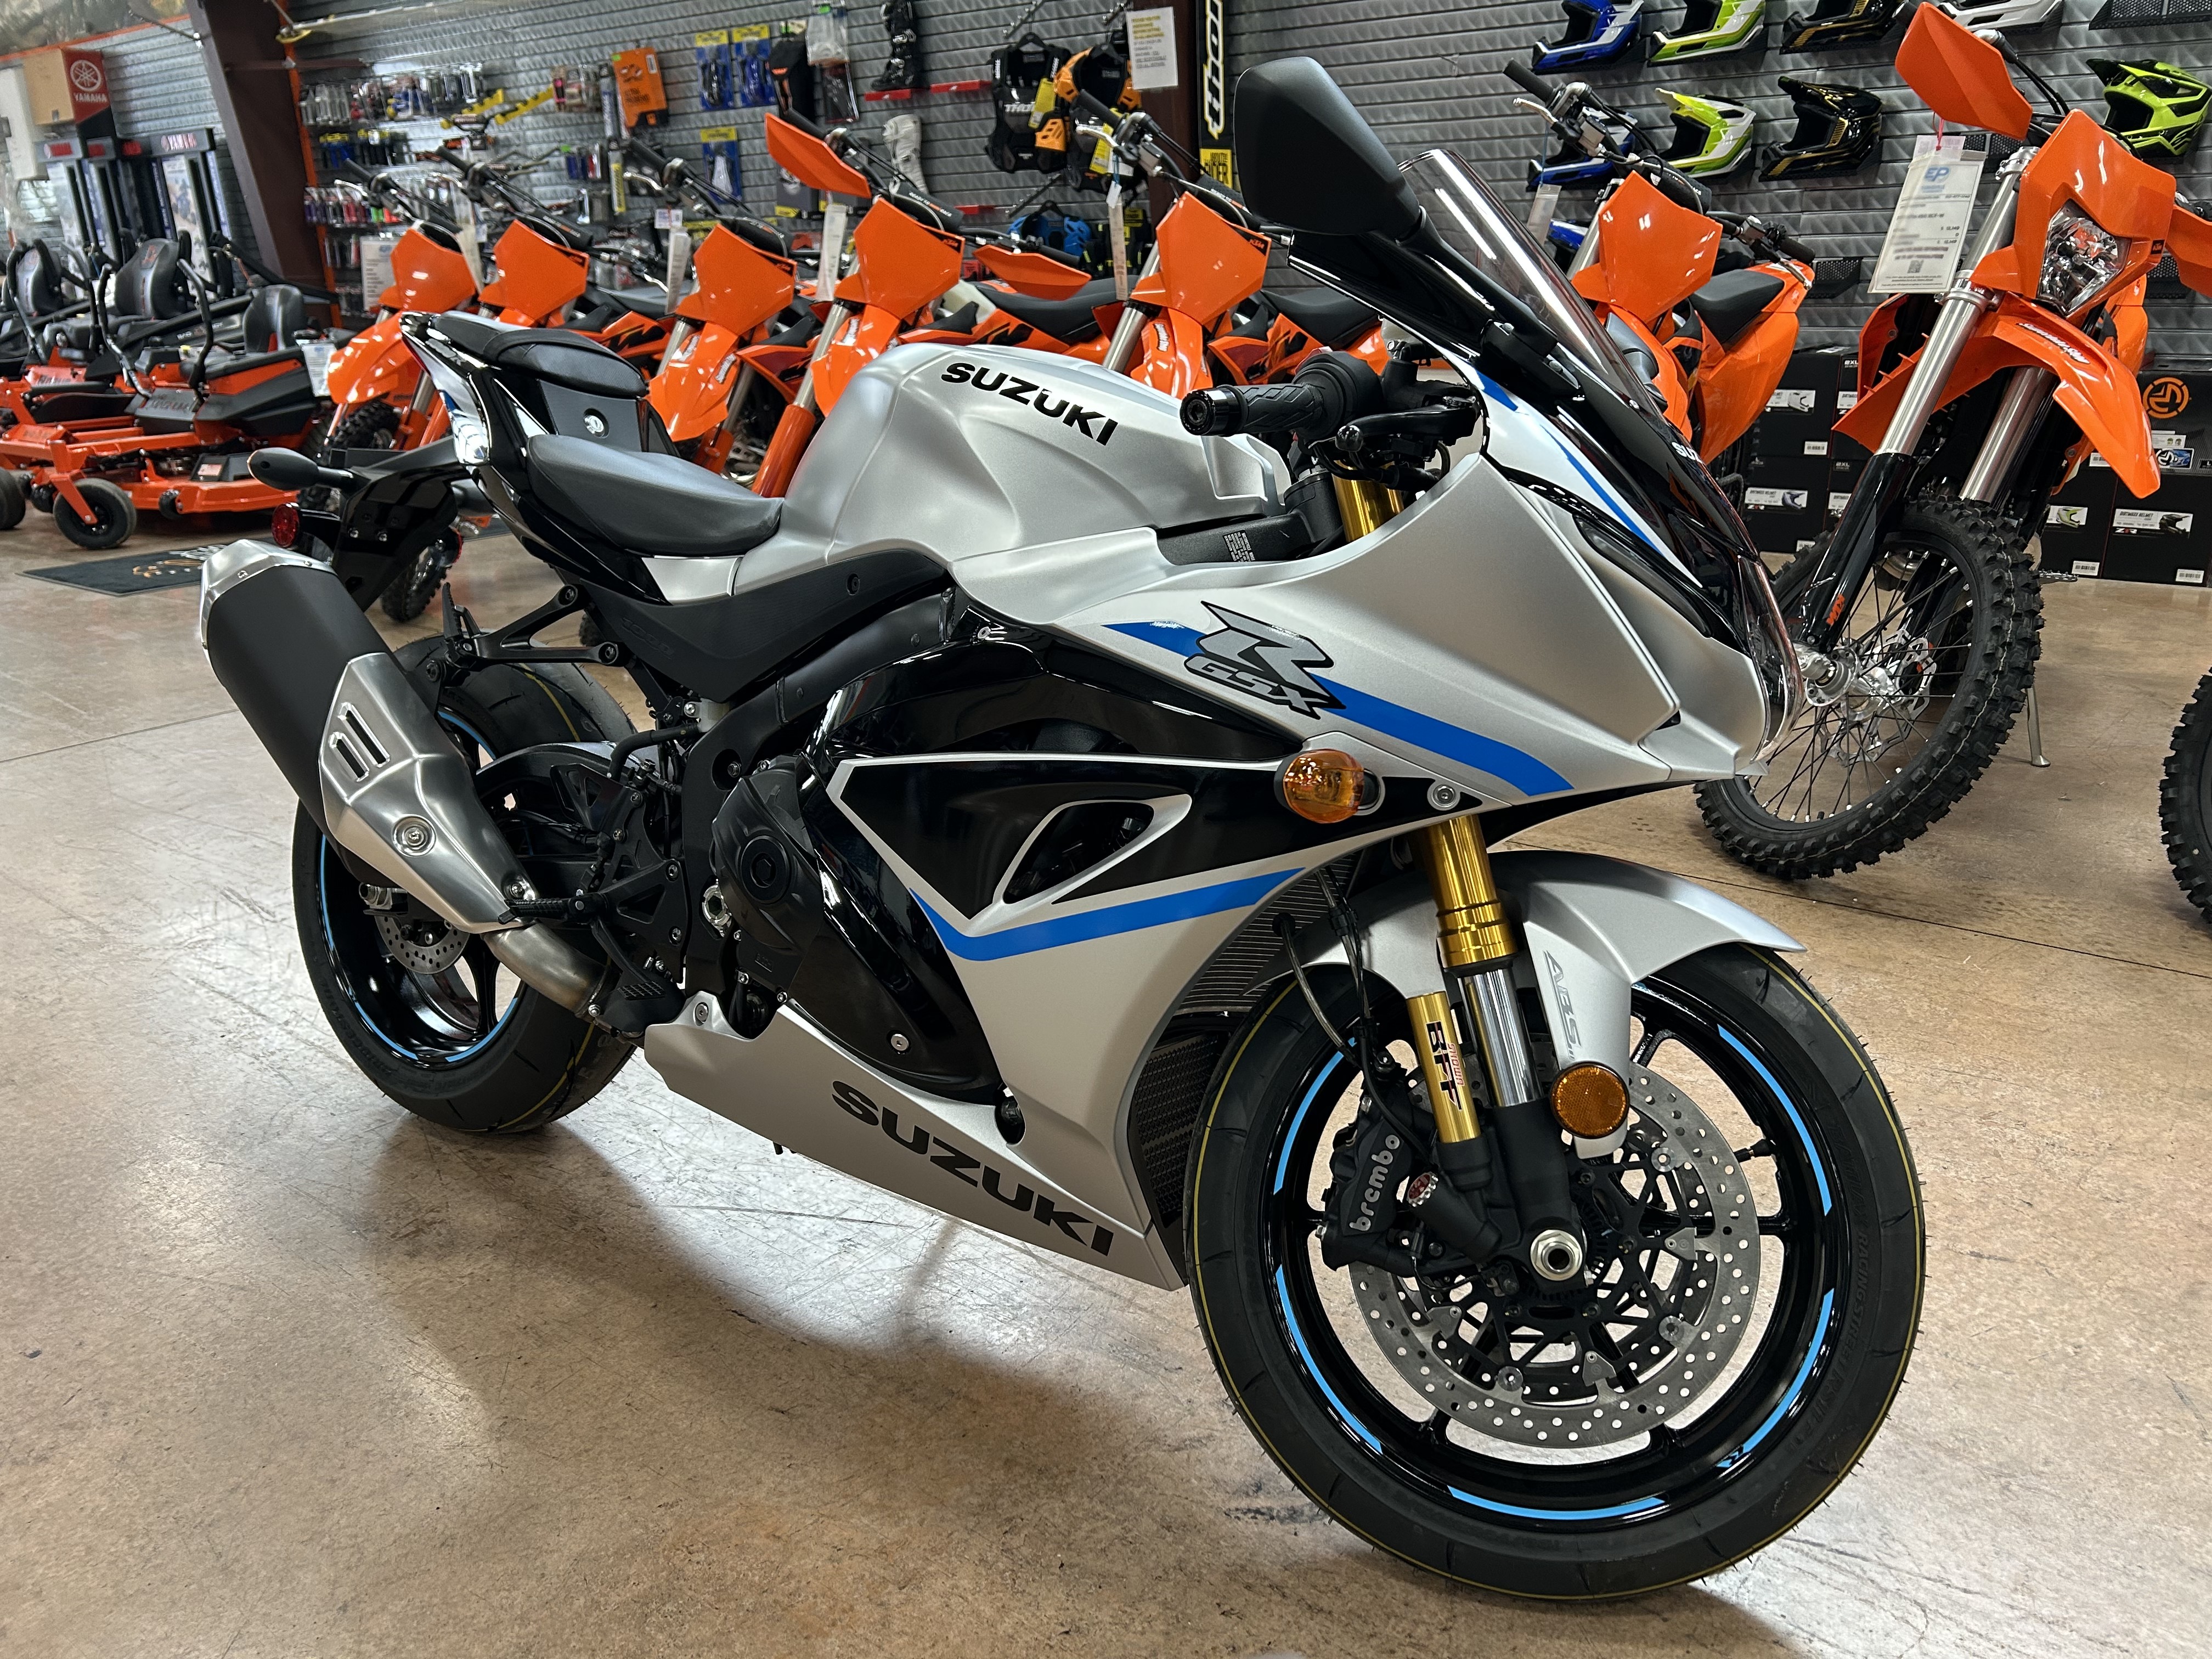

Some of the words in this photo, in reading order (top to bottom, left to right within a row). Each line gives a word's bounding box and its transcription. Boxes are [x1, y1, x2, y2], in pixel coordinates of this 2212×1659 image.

[74, 92, 108, 103] YAMAHA
[941, 363, 1118, 445] SUZUKI
[1184, 654, 1330, 716] GSX
[1543, 950, 1582, 1049] ABS
[1426, 1020, 1462, 1111] BFF
[1448, 1043, 1465, 1086] SHOWA
[832, 1080, 1114, 1256] SUZUKI
[1349, 1135, 1400, 1232] brembo
[1852, 1232, 1870, 1300] RACING
